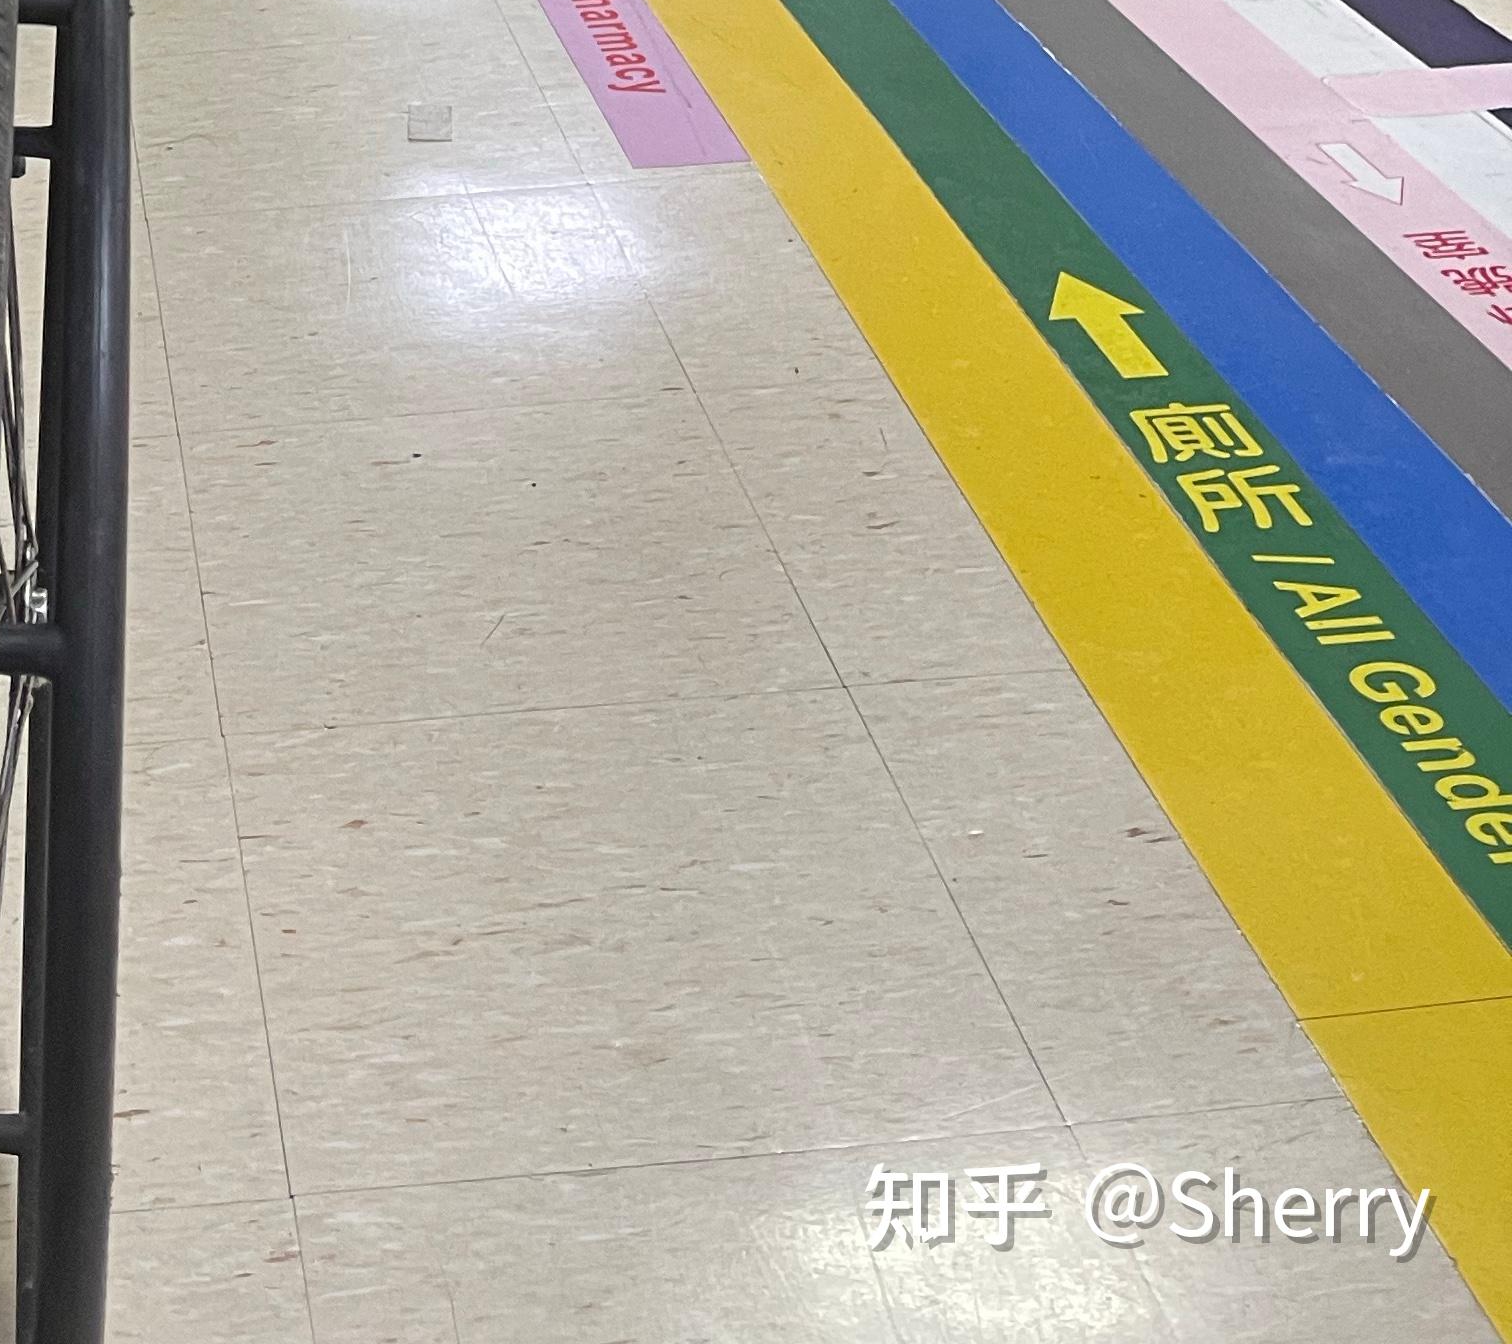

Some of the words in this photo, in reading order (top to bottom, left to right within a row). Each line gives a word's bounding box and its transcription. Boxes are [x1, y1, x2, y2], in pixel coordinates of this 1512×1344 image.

[1402, 230, 1512, 325] 號室
[1128, 400, 1314, 534] 廁所
[1272, 579, 1396, 648] All
